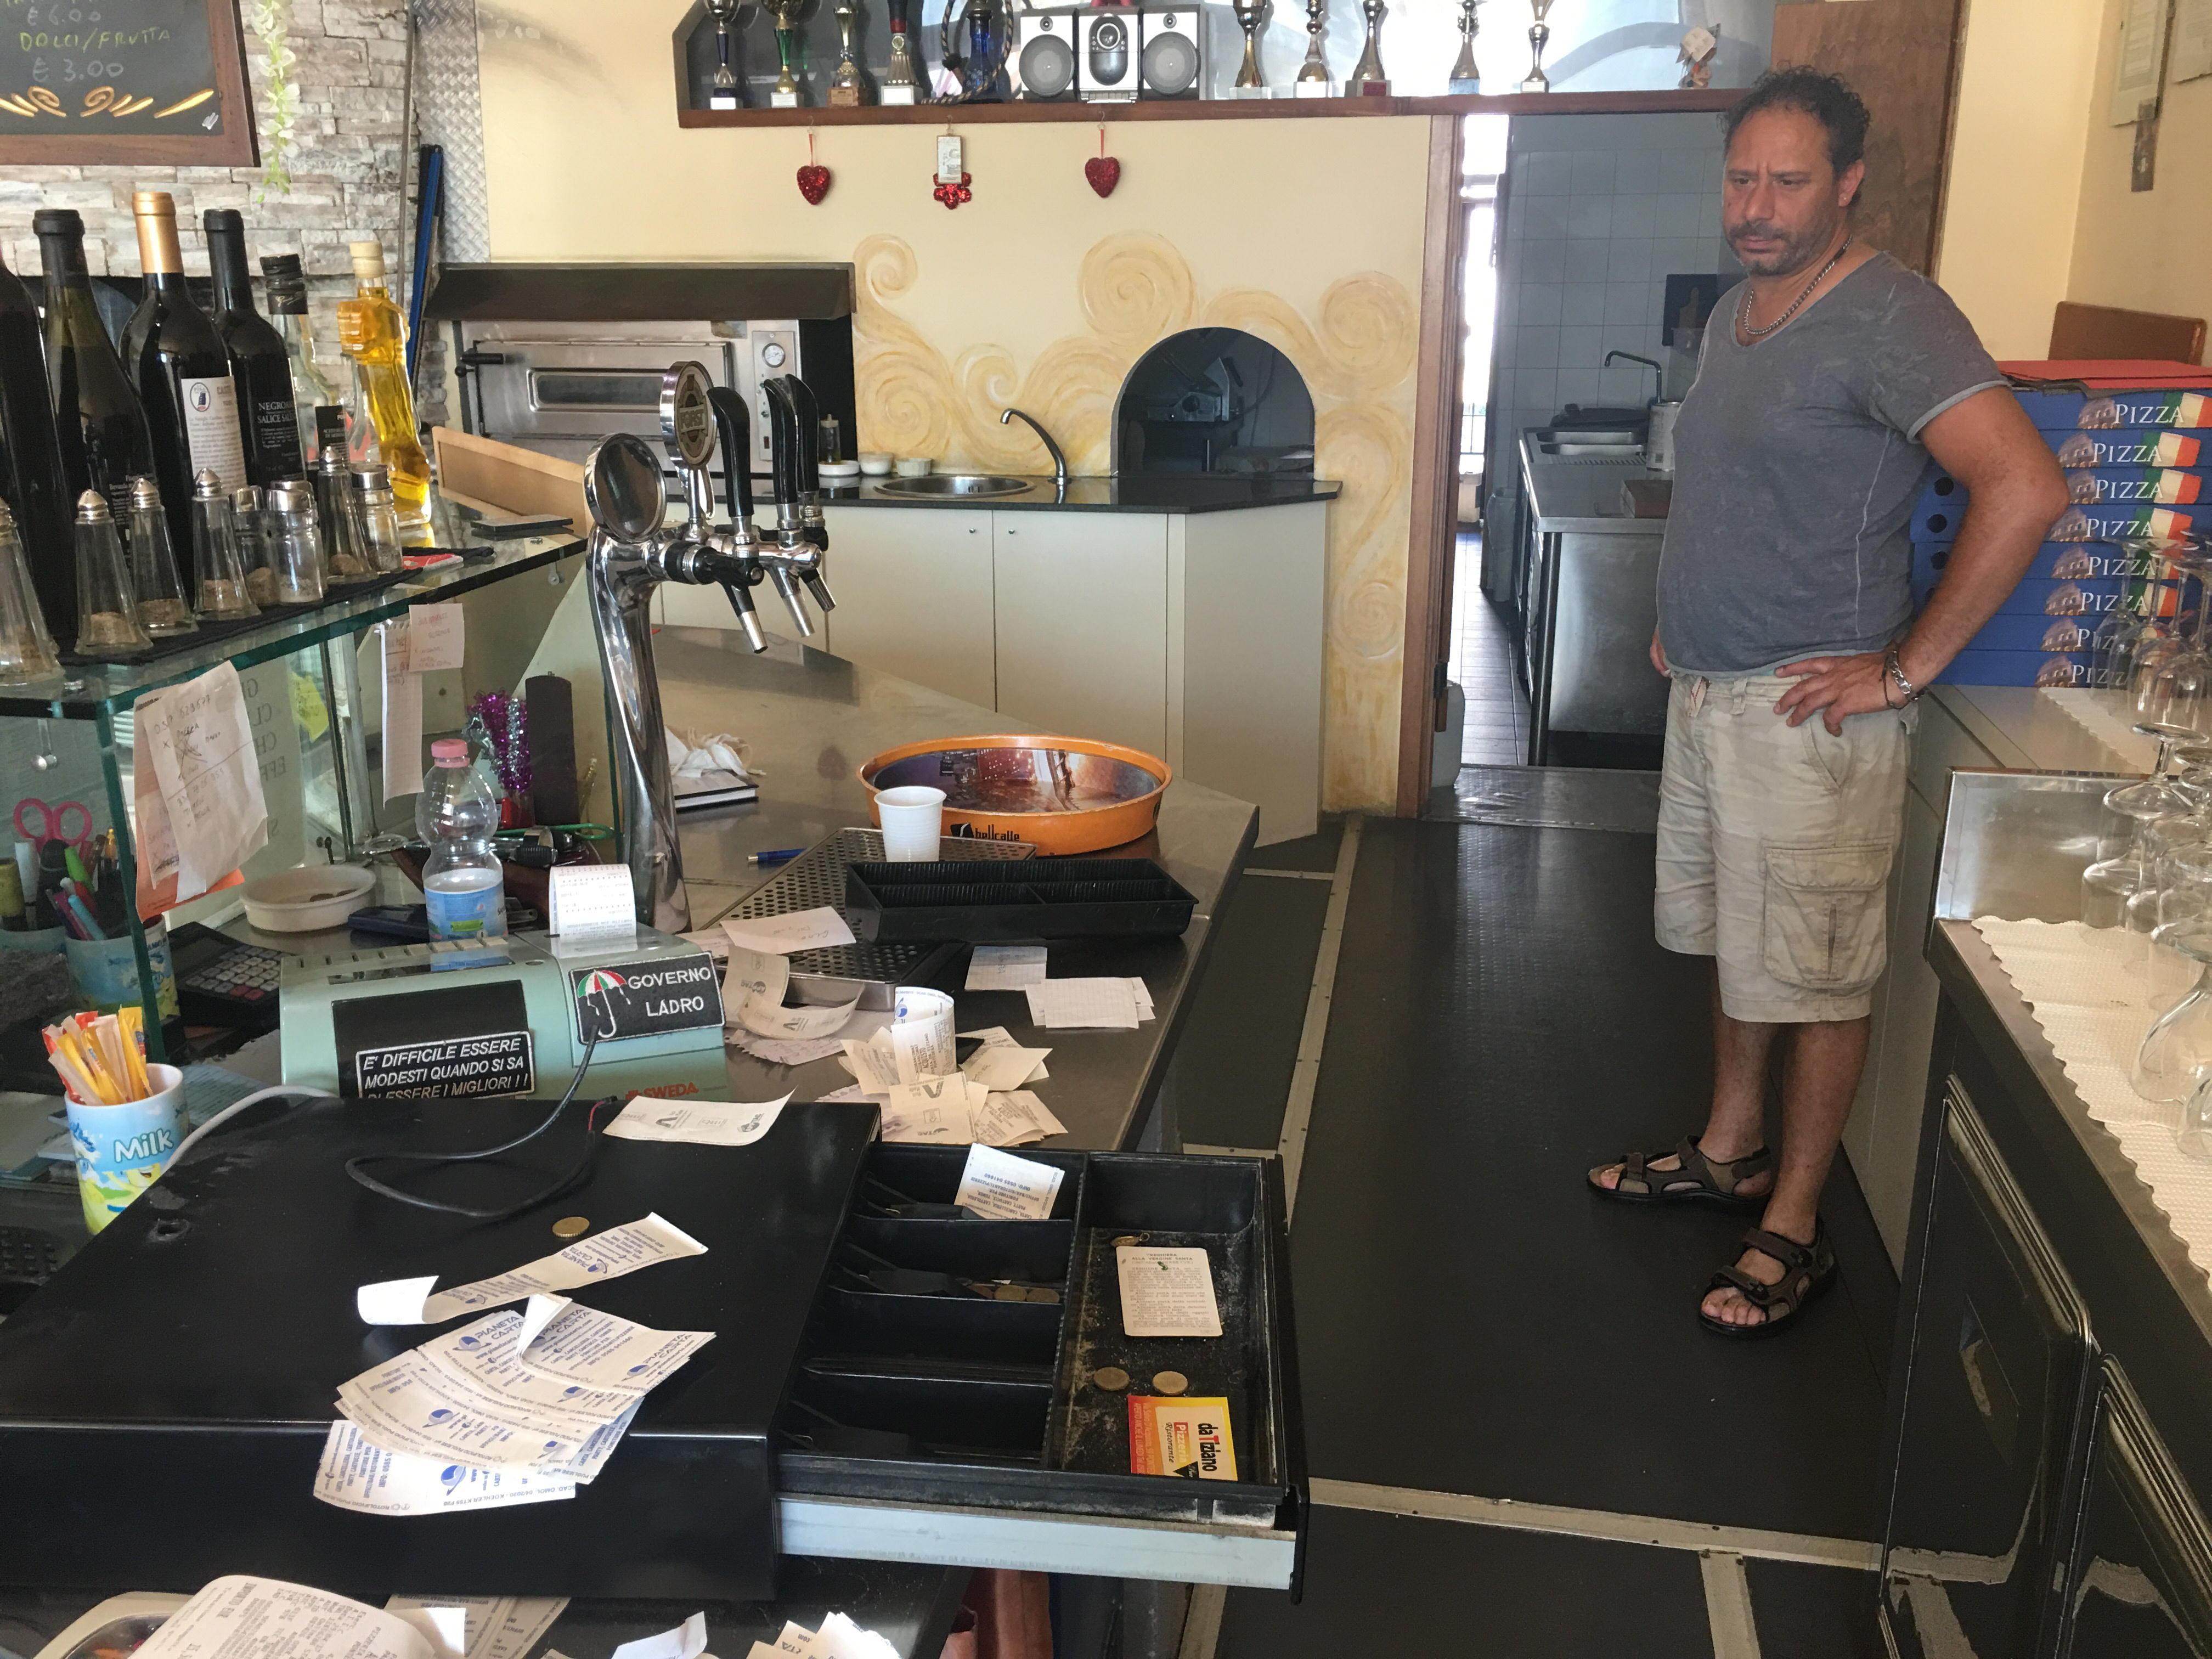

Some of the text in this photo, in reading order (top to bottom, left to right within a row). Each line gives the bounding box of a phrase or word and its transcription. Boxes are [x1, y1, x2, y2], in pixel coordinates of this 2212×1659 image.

[64, 59, 123, 82] 3.00
[257, 414, 281, 424] SALICE
[680, 410, 703, 429] FORST
[2114, 404, 2184, 424] PIZZA
[2093, 443, 2162, 463] PIZZA
[2096, 479, 2164, 499] PIZZA
[2086, 518, 2154, 538] PIZZA
[2088, 556, 2157, 575] PIZZA
[628, 967, 712, 989] GOVERNO
[646, 996, 704, 1017] LADRO
[381, 1046, 458, 1068] DIFFICILE
[460, 1037, 522, 1058] ESSERE
[365, 1055, 524, 1089] MODESTI QUANDO SI SA
[385, 1084, 442, 1099] ESSERE
[451, 1075, 512, 1097] MIGLIORI
[644, 1082, 699, 1098] SWEDA
[114, 1128, 174, 1163] Milk
[561, 1250, 590, 1268] PIANETA
[569, 1246, 593, 1261] CARTA
[475, 1316, 520, 1339] PIANETA
[491, 1321, 524, 1340] CARTA
[541, 1308, 585, 1335] PIANETA
[556, 1311, 592, 1333] CARTA
[642, 1333, 687, 1364] PIANETA
[658, 1334, 695, 1358] CARTA
[1165, 1421, 1175, 1464] Ristorante
[1175, 1424, 1188, 1463] Pizzeria
